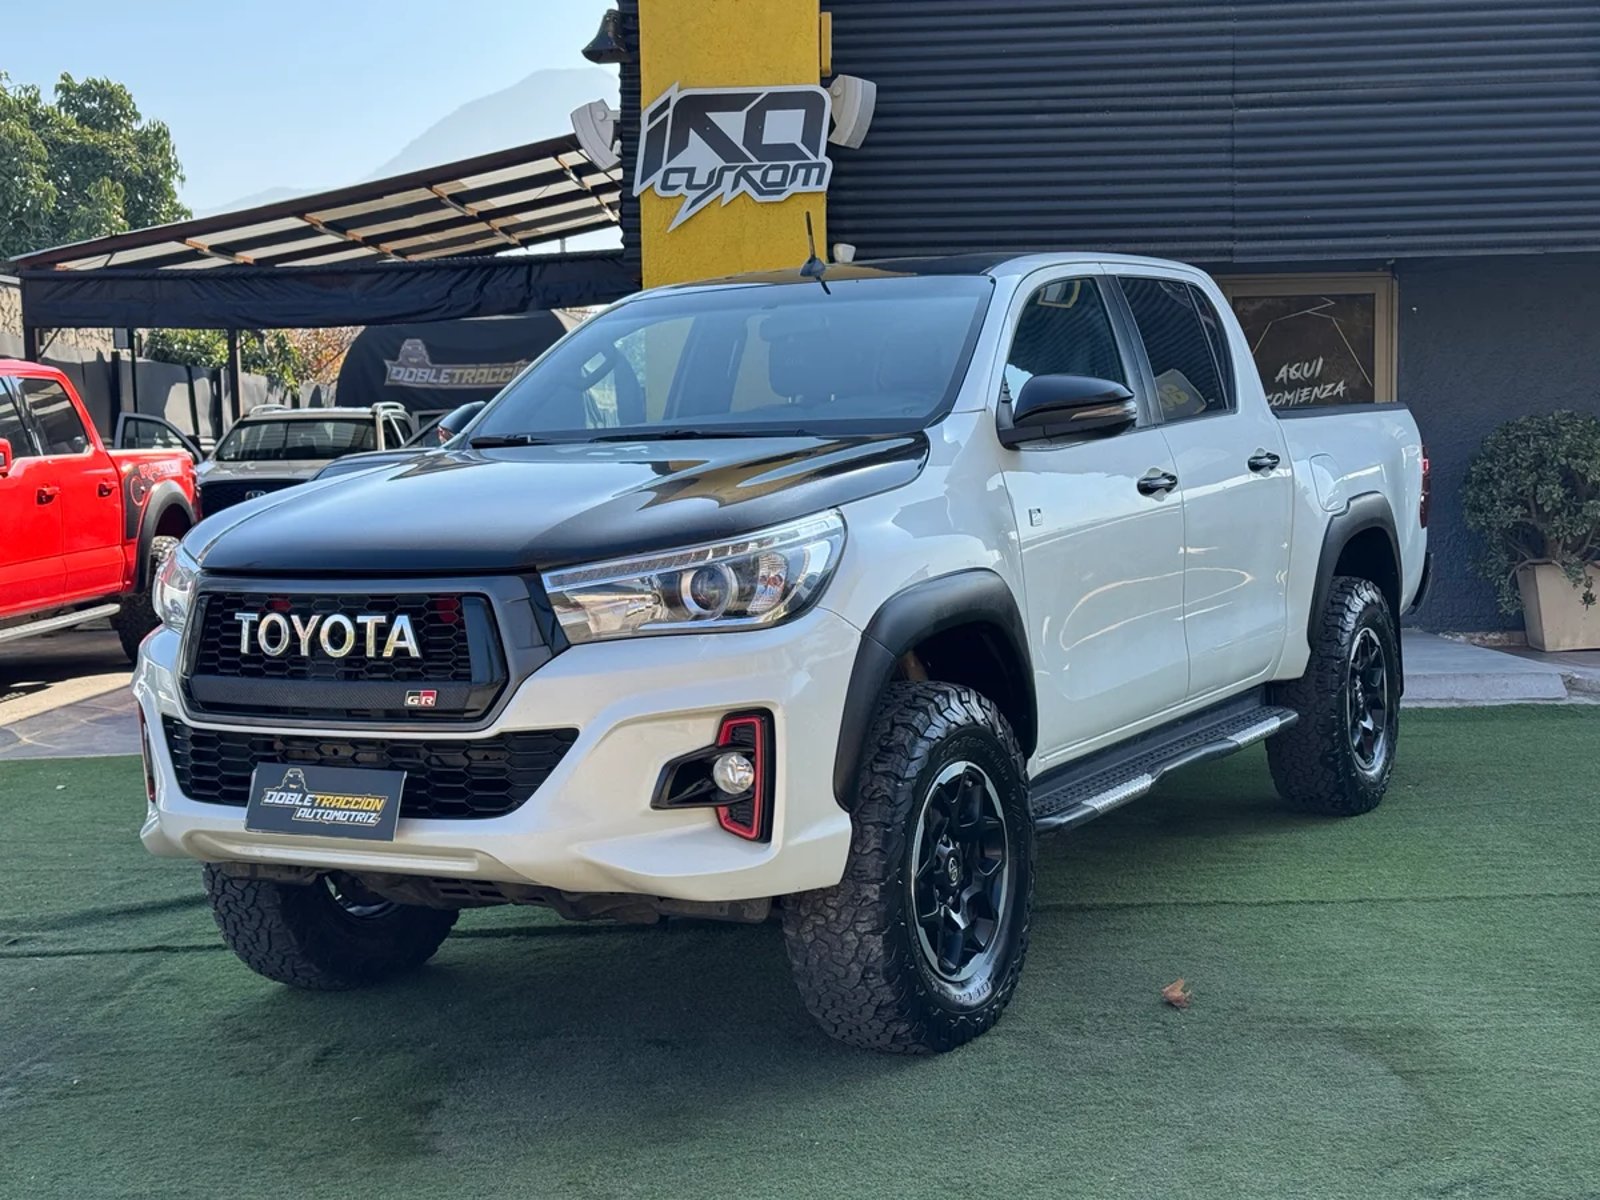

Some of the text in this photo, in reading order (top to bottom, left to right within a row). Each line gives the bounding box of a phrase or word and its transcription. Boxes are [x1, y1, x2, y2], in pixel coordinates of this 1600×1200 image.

[1275, 355, 1324, 384] AQUI
[234, 612, 421, 658] TOYOTA
[406, 694, 435, 706] GR
[296, 807, 377, 823] AUTOMOTRIZ
